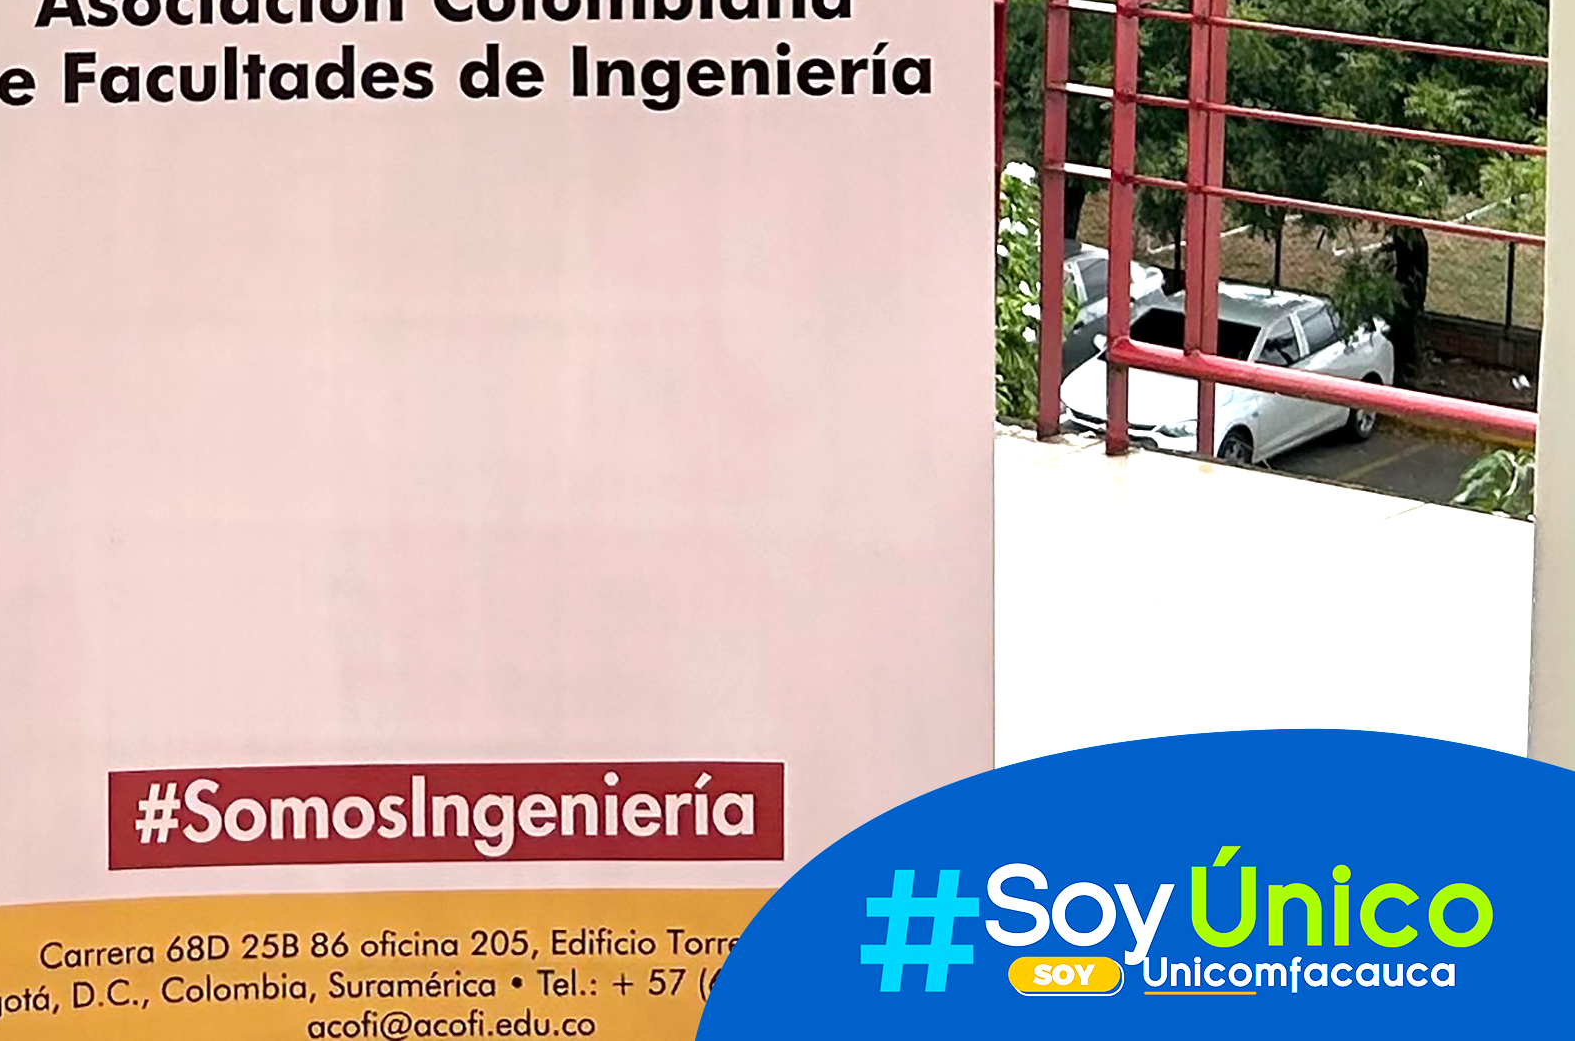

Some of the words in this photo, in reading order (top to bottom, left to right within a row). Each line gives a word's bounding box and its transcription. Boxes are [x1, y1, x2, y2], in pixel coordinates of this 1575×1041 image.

[65, 45, 433, 103] Facultades
[460, 44, 544, 98] de
[573, 42, 931, 111] Ingeniería
[135, 771, 756, 858] #SomosIngeniería
[40, 942, 154, 969] Carrera
[167, 936, 229, 962] 68D
[242, 934, 299, 959] 25B
[311, 932, 348, 957] 86
[361, 930, 458, 957] oficina
[471, 930, 538, 960] 205,
[552, 928, 656, 955] Edificio
[74, 979, 149, 1009] D.C.,
[162, 972, 315, 1003] Colombia,
[329, 970, 495, 998] Suramérica
[537, 968, 596, 996] Tel.:
[649, 969, 686, 995] 57
[308, 1008, 595, 1041] acofi@acofi.edu.co
